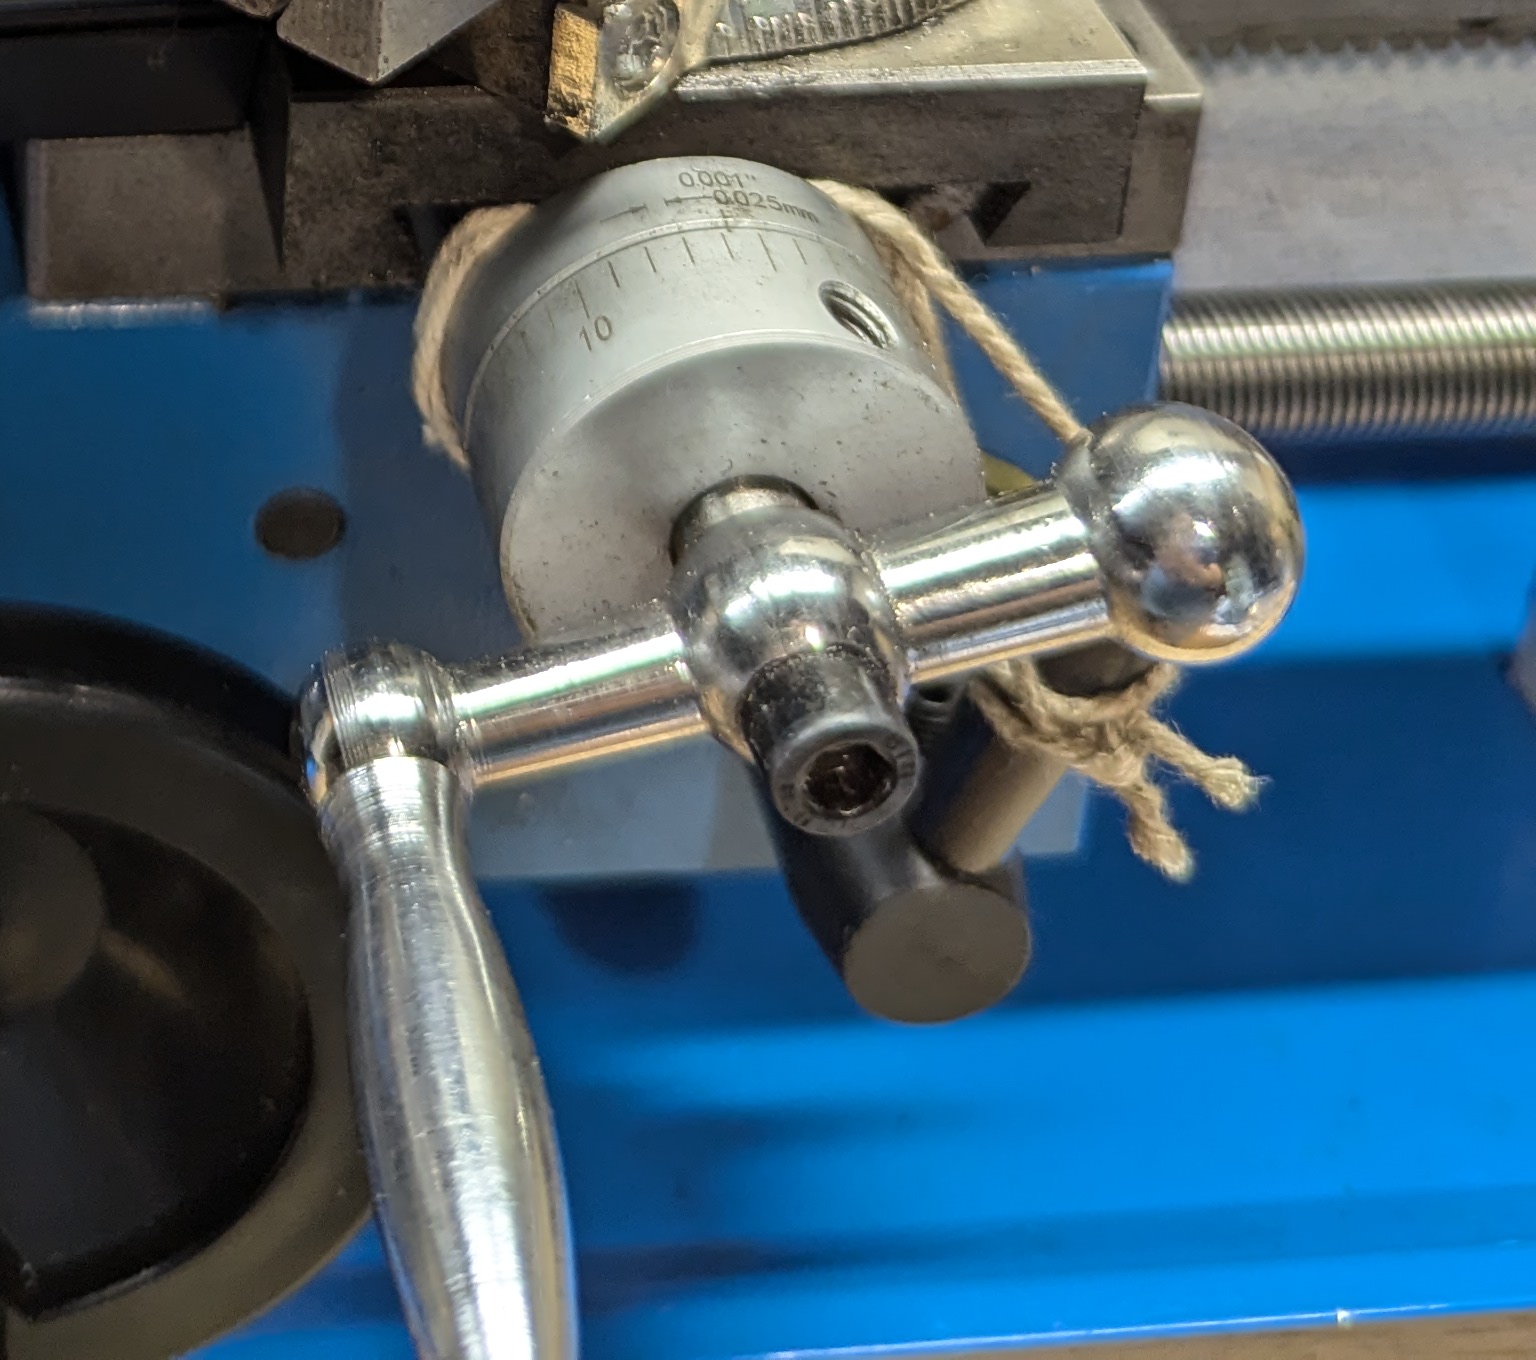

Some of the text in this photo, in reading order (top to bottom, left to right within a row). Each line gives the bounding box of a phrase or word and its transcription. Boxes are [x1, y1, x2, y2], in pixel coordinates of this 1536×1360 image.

[677, 169, 757, 189] 0.001"
[713, 188, 820, 225] 0.025mm
[579, 314, 613, 352] 10
